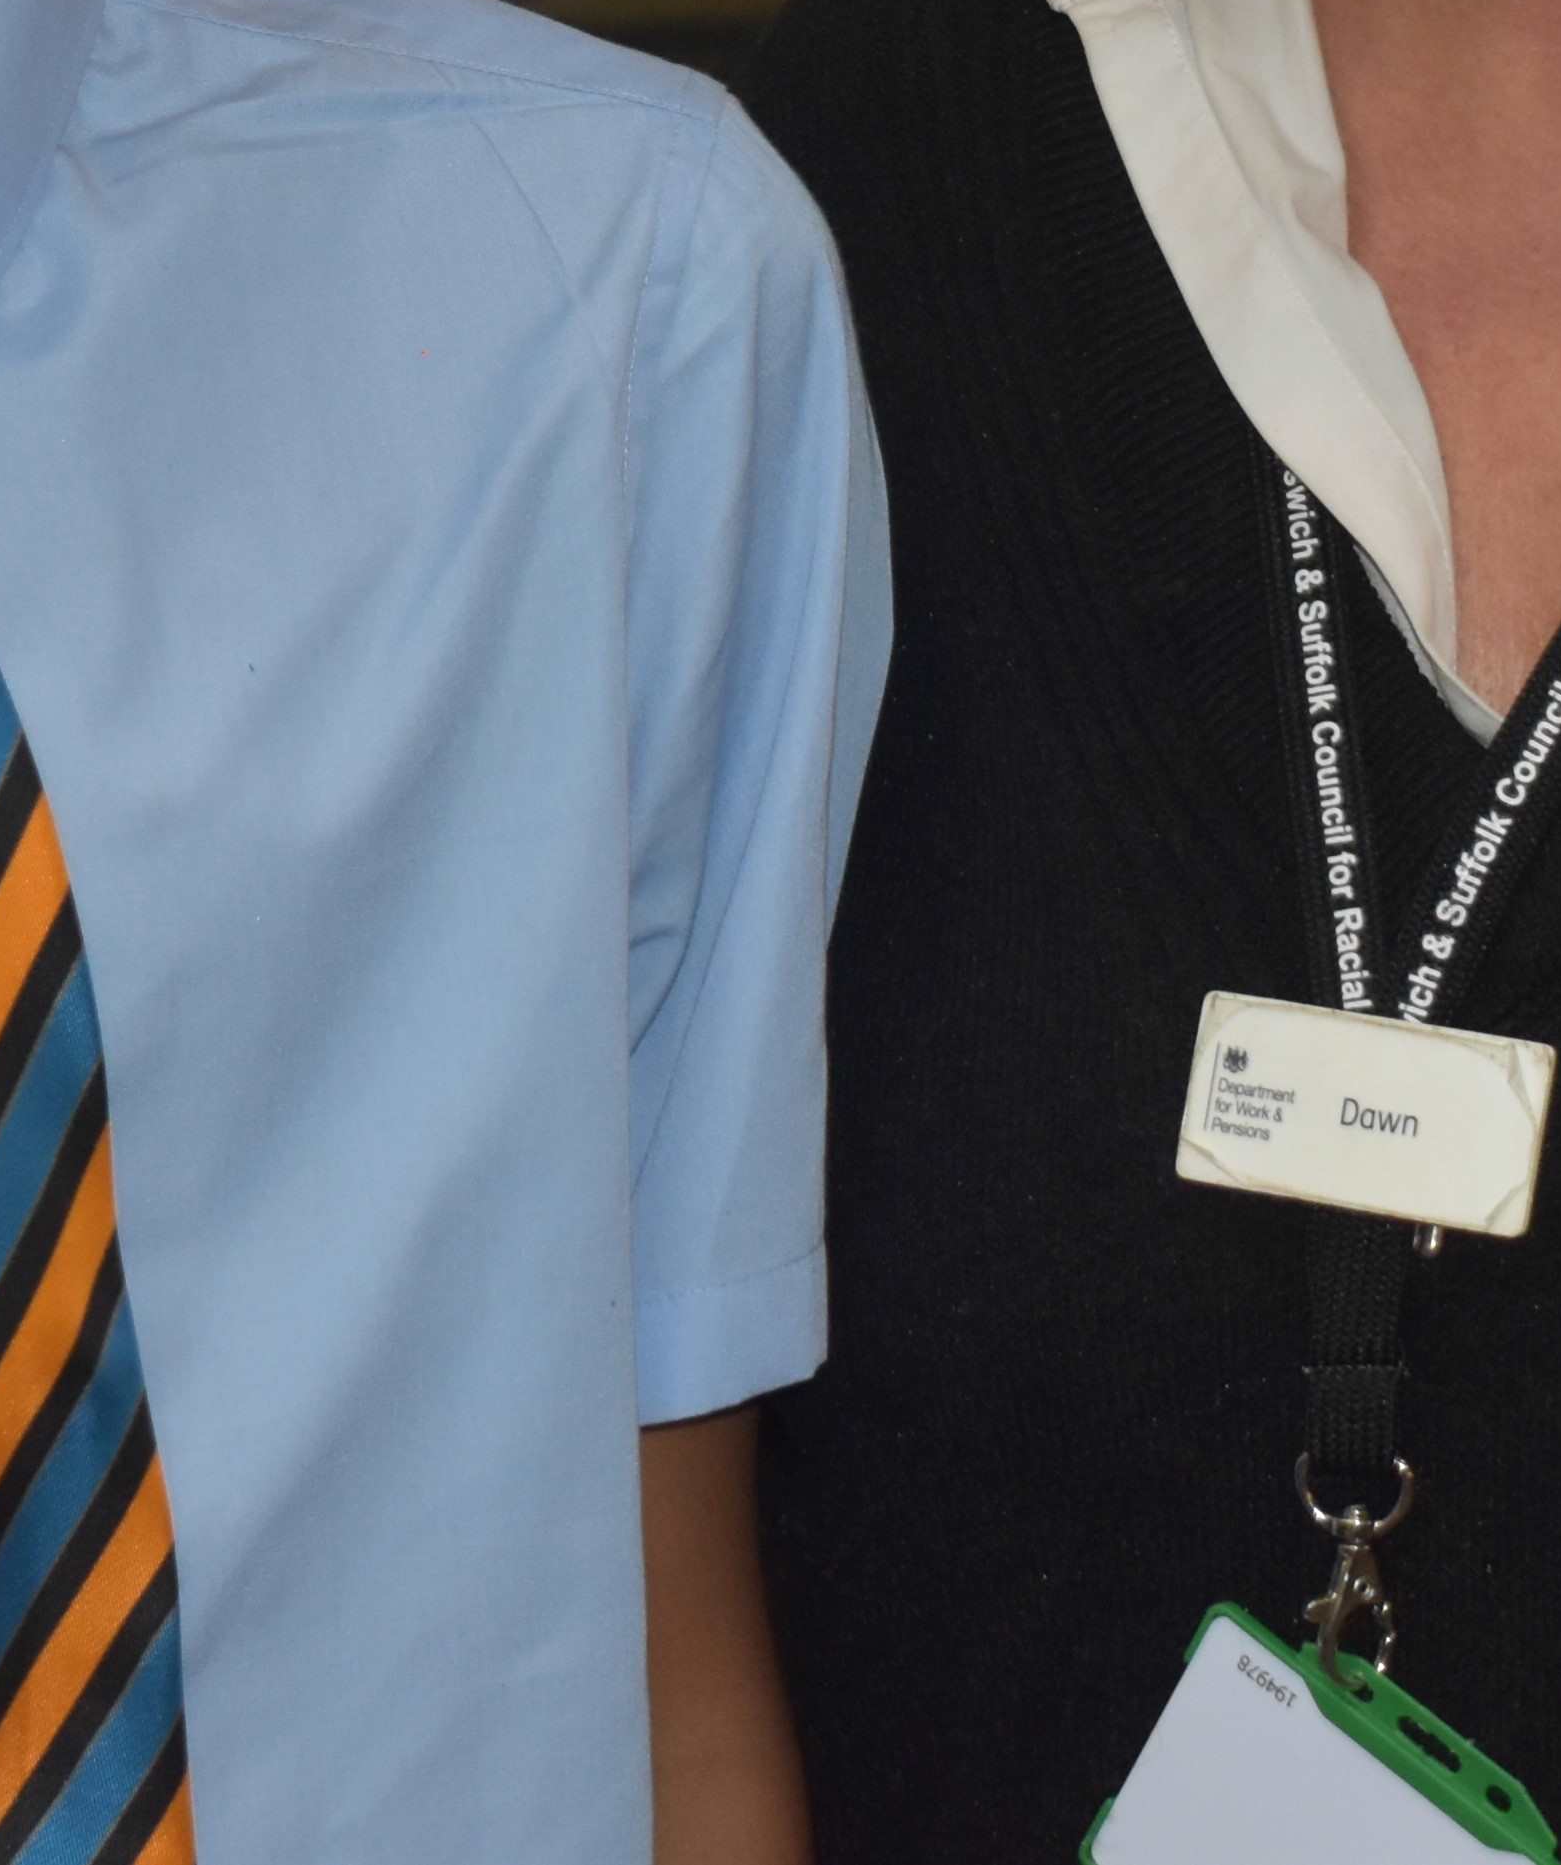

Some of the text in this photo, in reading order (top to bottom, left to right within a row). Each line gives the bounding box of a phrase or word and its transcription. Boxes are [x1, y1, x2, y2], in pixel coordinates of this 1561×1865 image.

[1295, 569, 1324, 594] &
[1298, 599, 1338, 715] Suffolk
[1312, 721, 1354, 846] Council
[1327, 850, 1359, 900] for
[1436, 811, 1513, 927] Suffolk
[1334, 907, 1373, 1010] Racial
[1422, 934, 1455, 960] &
[1214, 1096, 1284, 1123] for Work &
[1217, 1076, 1296, 1105] Department
[1211, 1116, 1271, 1142] Pensions
[1339, 1096, 1419, 1137] Dawn
[1237, 1654, 1297, 1707] 194978
